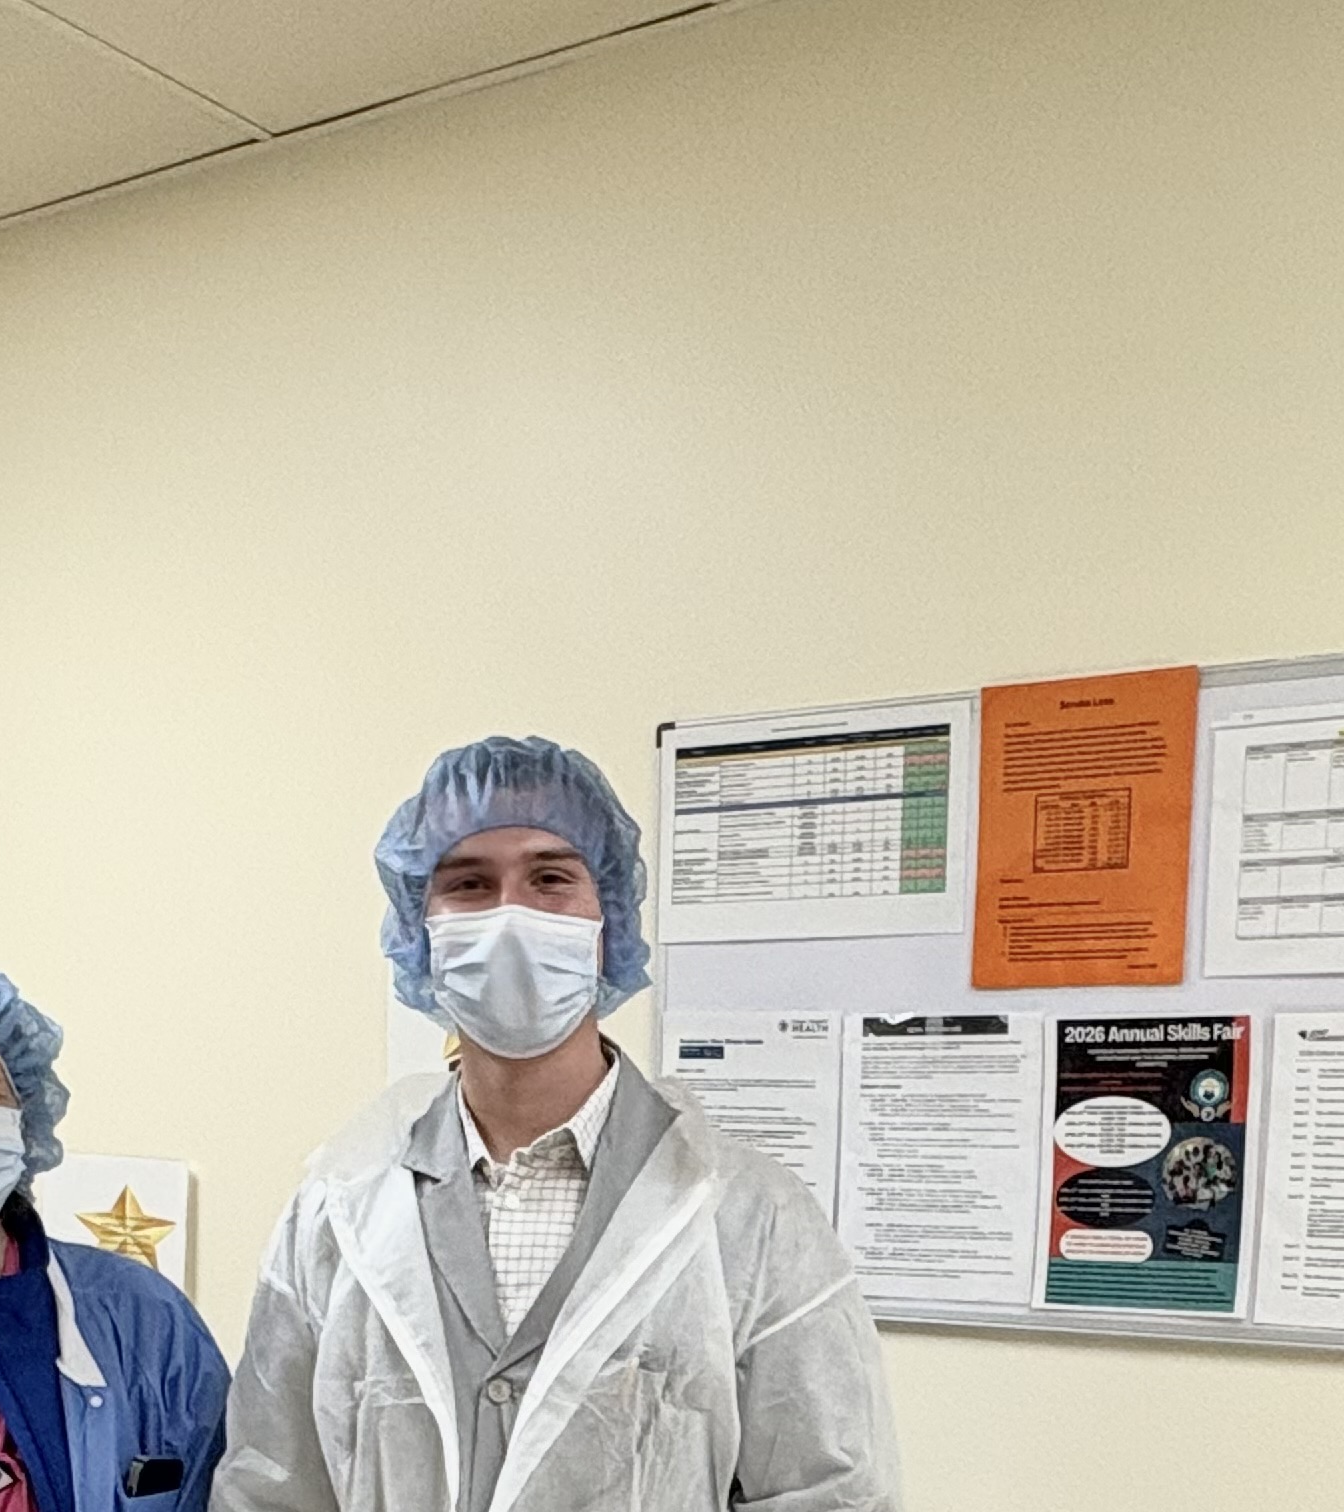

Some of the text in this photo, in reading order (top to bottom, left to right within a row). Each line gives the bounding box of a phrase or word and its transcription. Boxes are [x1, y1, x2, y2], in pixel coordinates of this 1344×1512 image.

[1064, 1022, 1245, 1044] 2026 Annual Skills Fair
